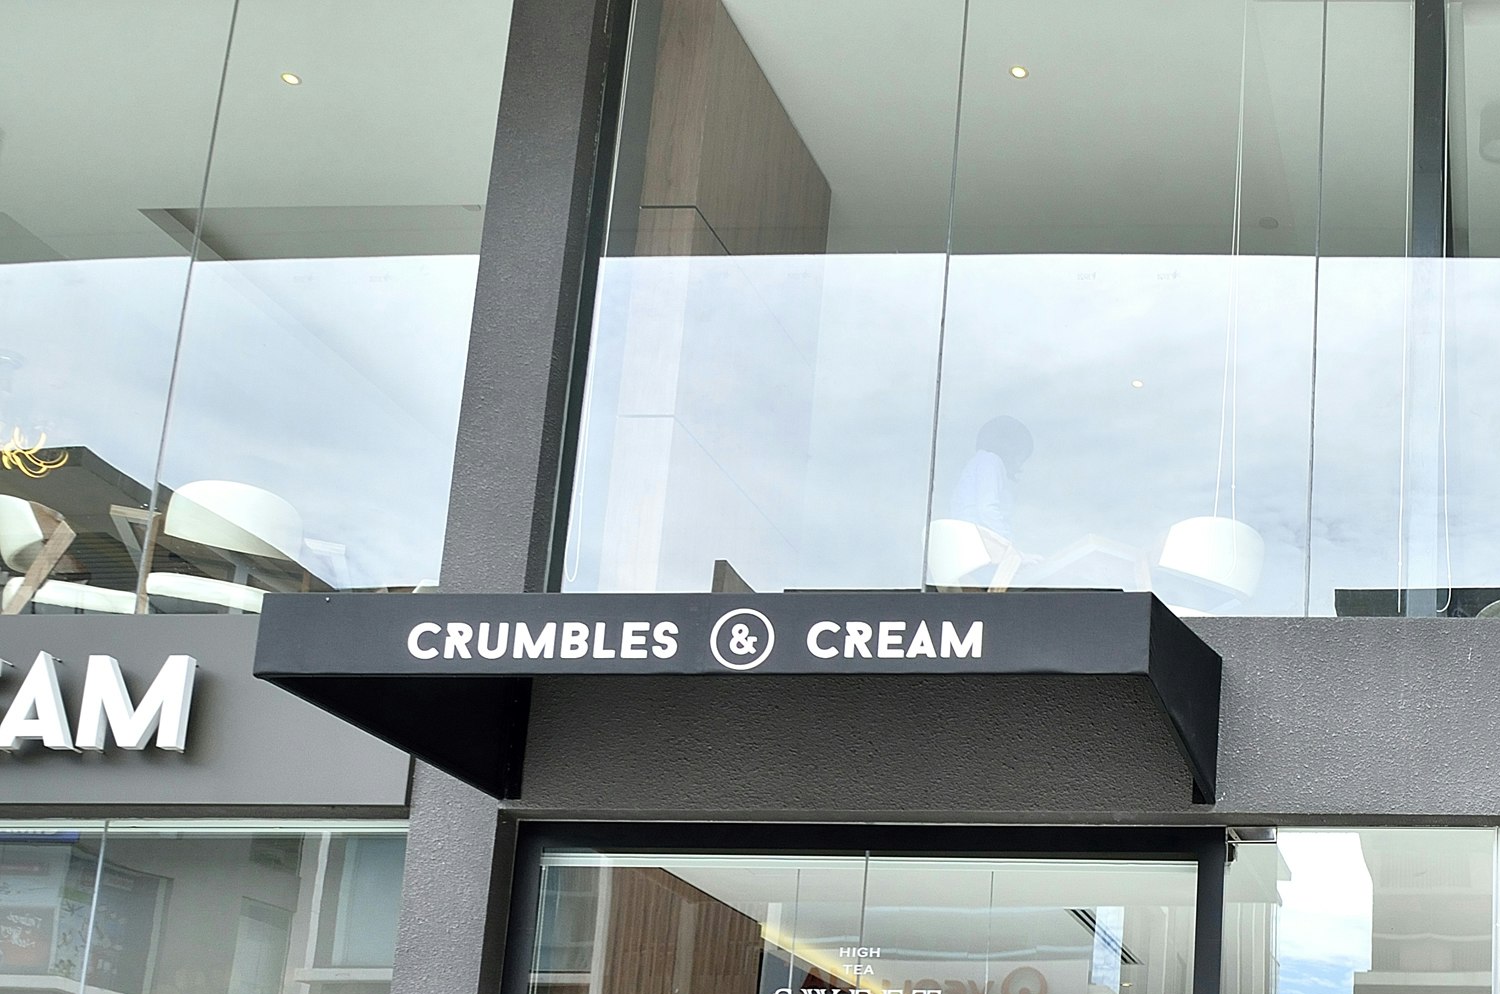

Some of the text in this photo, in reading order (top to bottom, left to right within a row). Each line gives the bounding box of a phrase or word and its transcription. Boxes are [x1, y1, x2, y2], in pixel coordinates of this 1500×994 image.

[407, 621, 679, 660] CRUMBLES
[806, 620, 984, 659] CREAM
[839, 947, 881, 958] HIGH
[843, 964, 875, 975] TEA
